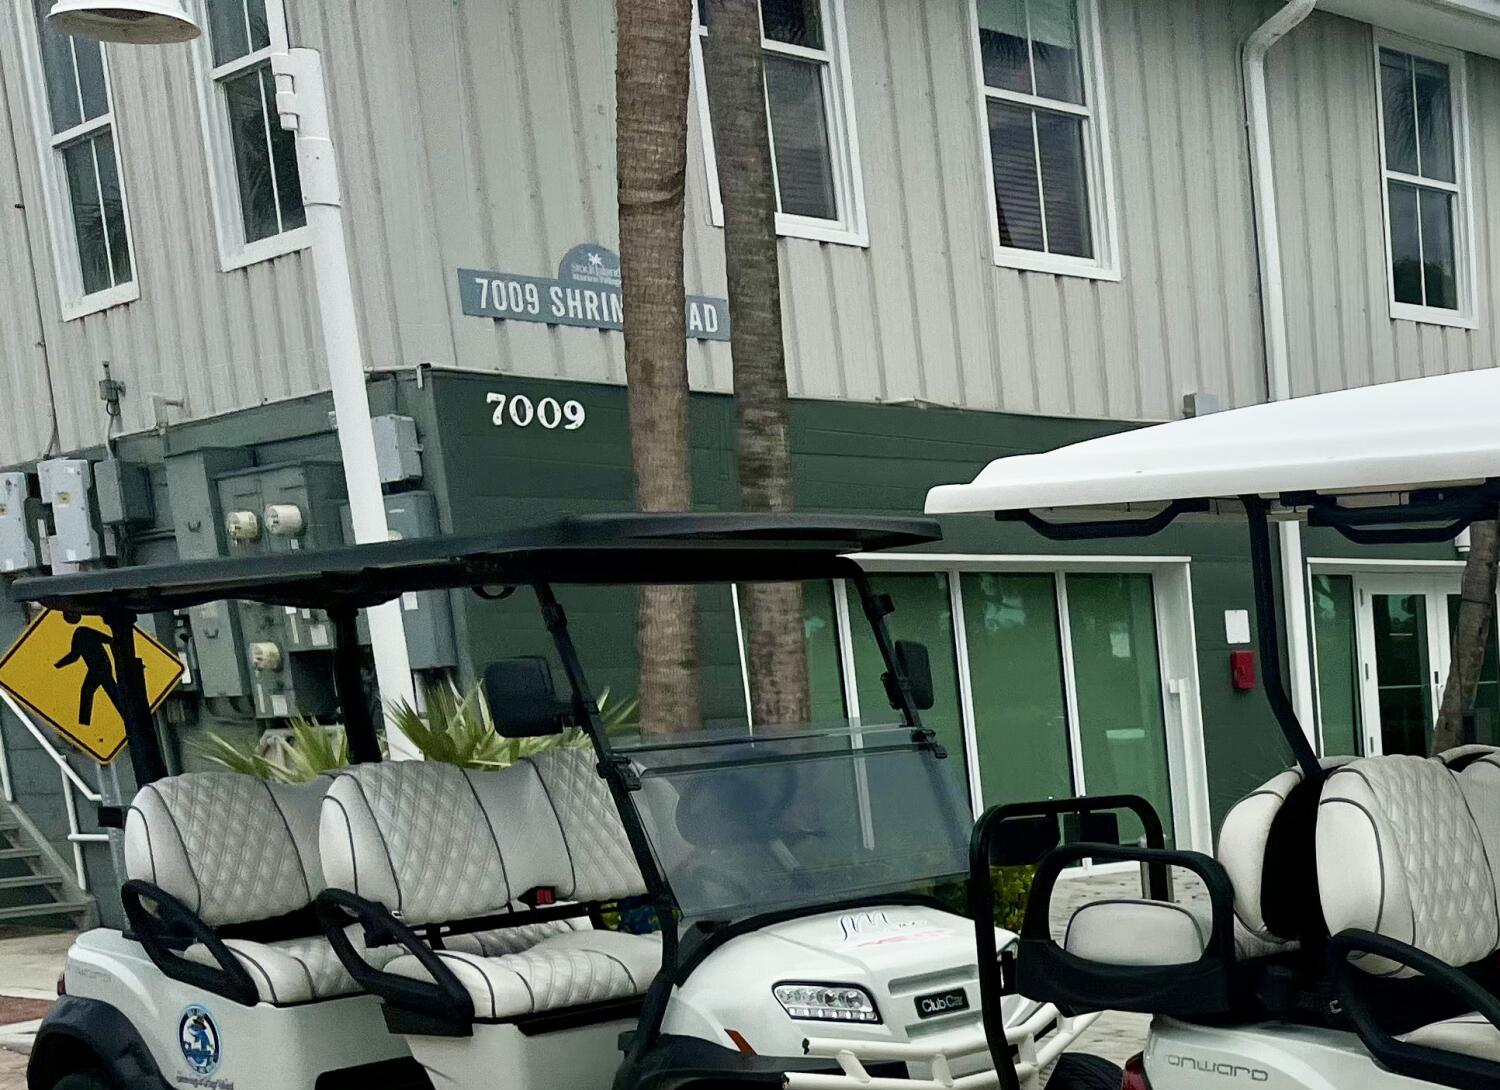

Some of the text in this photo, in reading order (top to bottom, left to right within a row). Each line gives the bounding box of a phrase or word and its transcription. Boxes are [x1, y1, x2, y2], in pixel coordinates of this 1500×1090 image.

[474, 277, 718, 333] 7009 SHRIM AD
[486, 391, 586, 430] 7009
[922, 997, 946, 1012] Club
